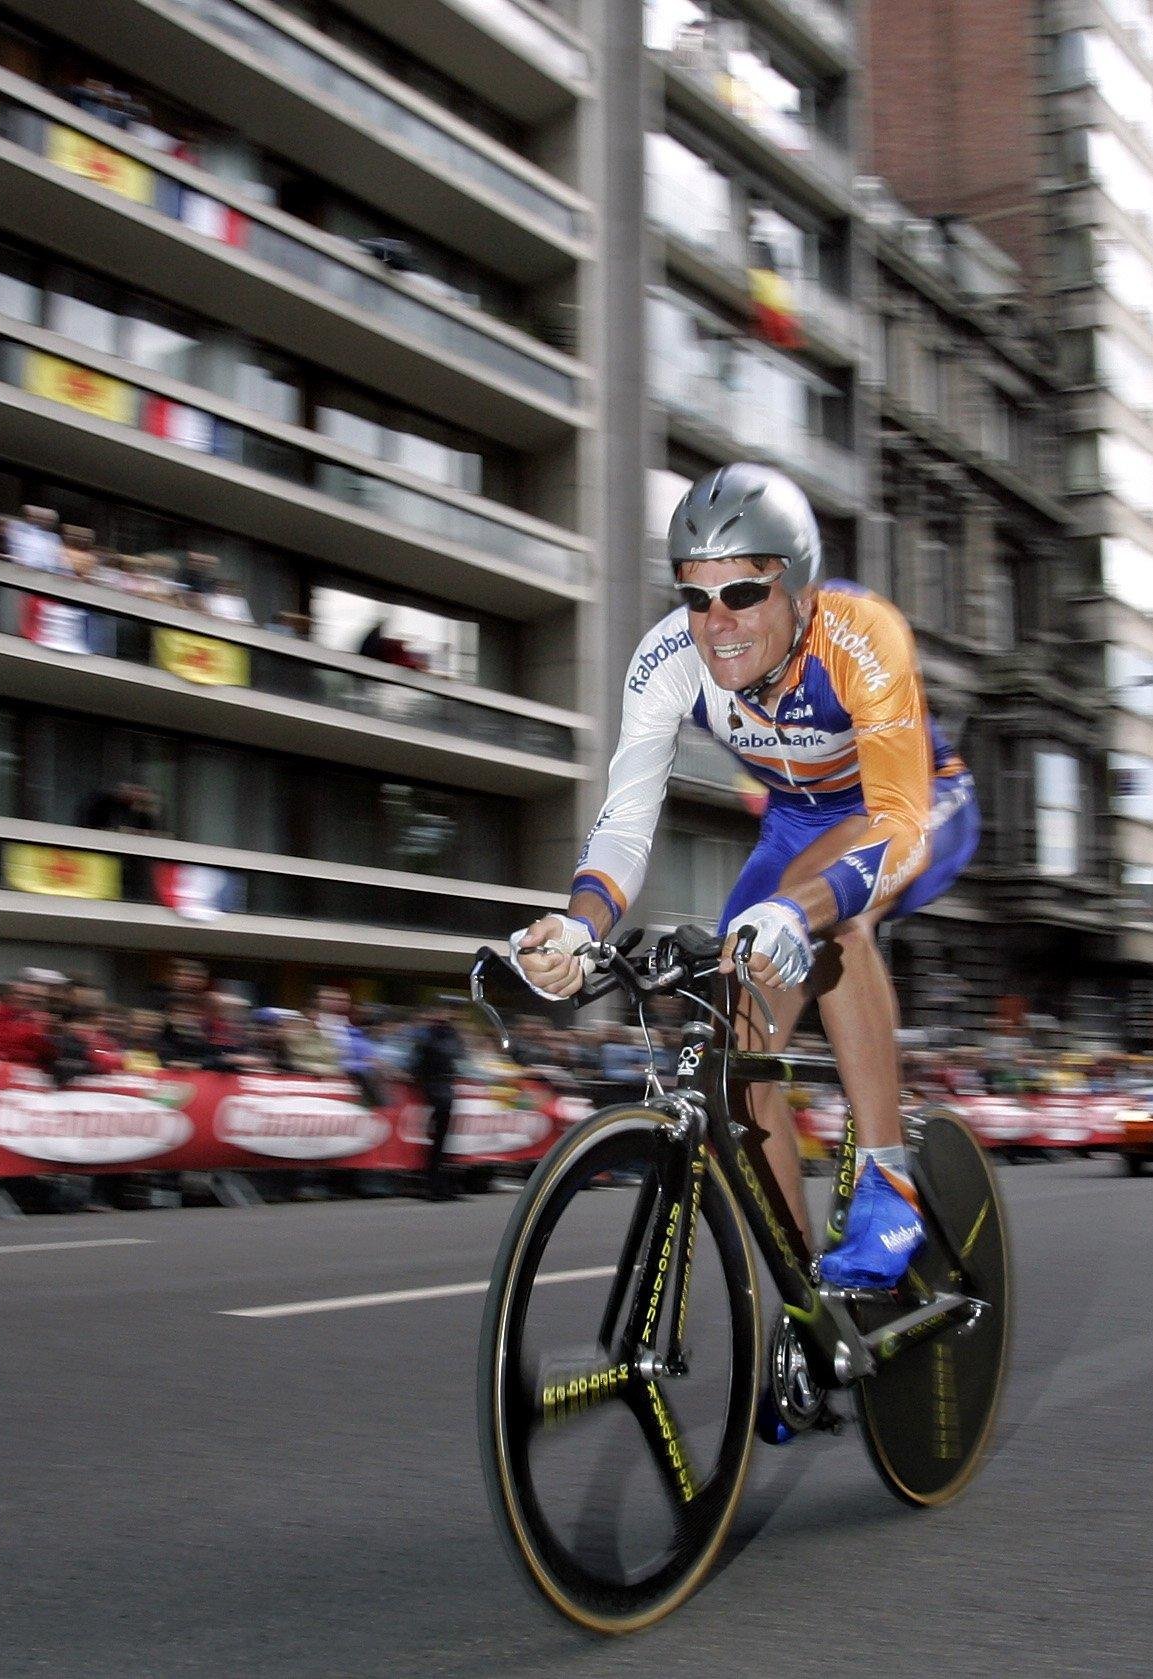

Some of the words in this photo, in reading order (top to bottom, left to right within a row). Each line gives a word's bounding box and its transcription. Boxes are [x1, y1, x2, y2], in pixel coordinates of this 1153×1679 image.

[628, 628, 694, 694] Raboba
[823, 610, 891, 692] Rbobank
[642, 1202, 680, 1343] Rabobank
